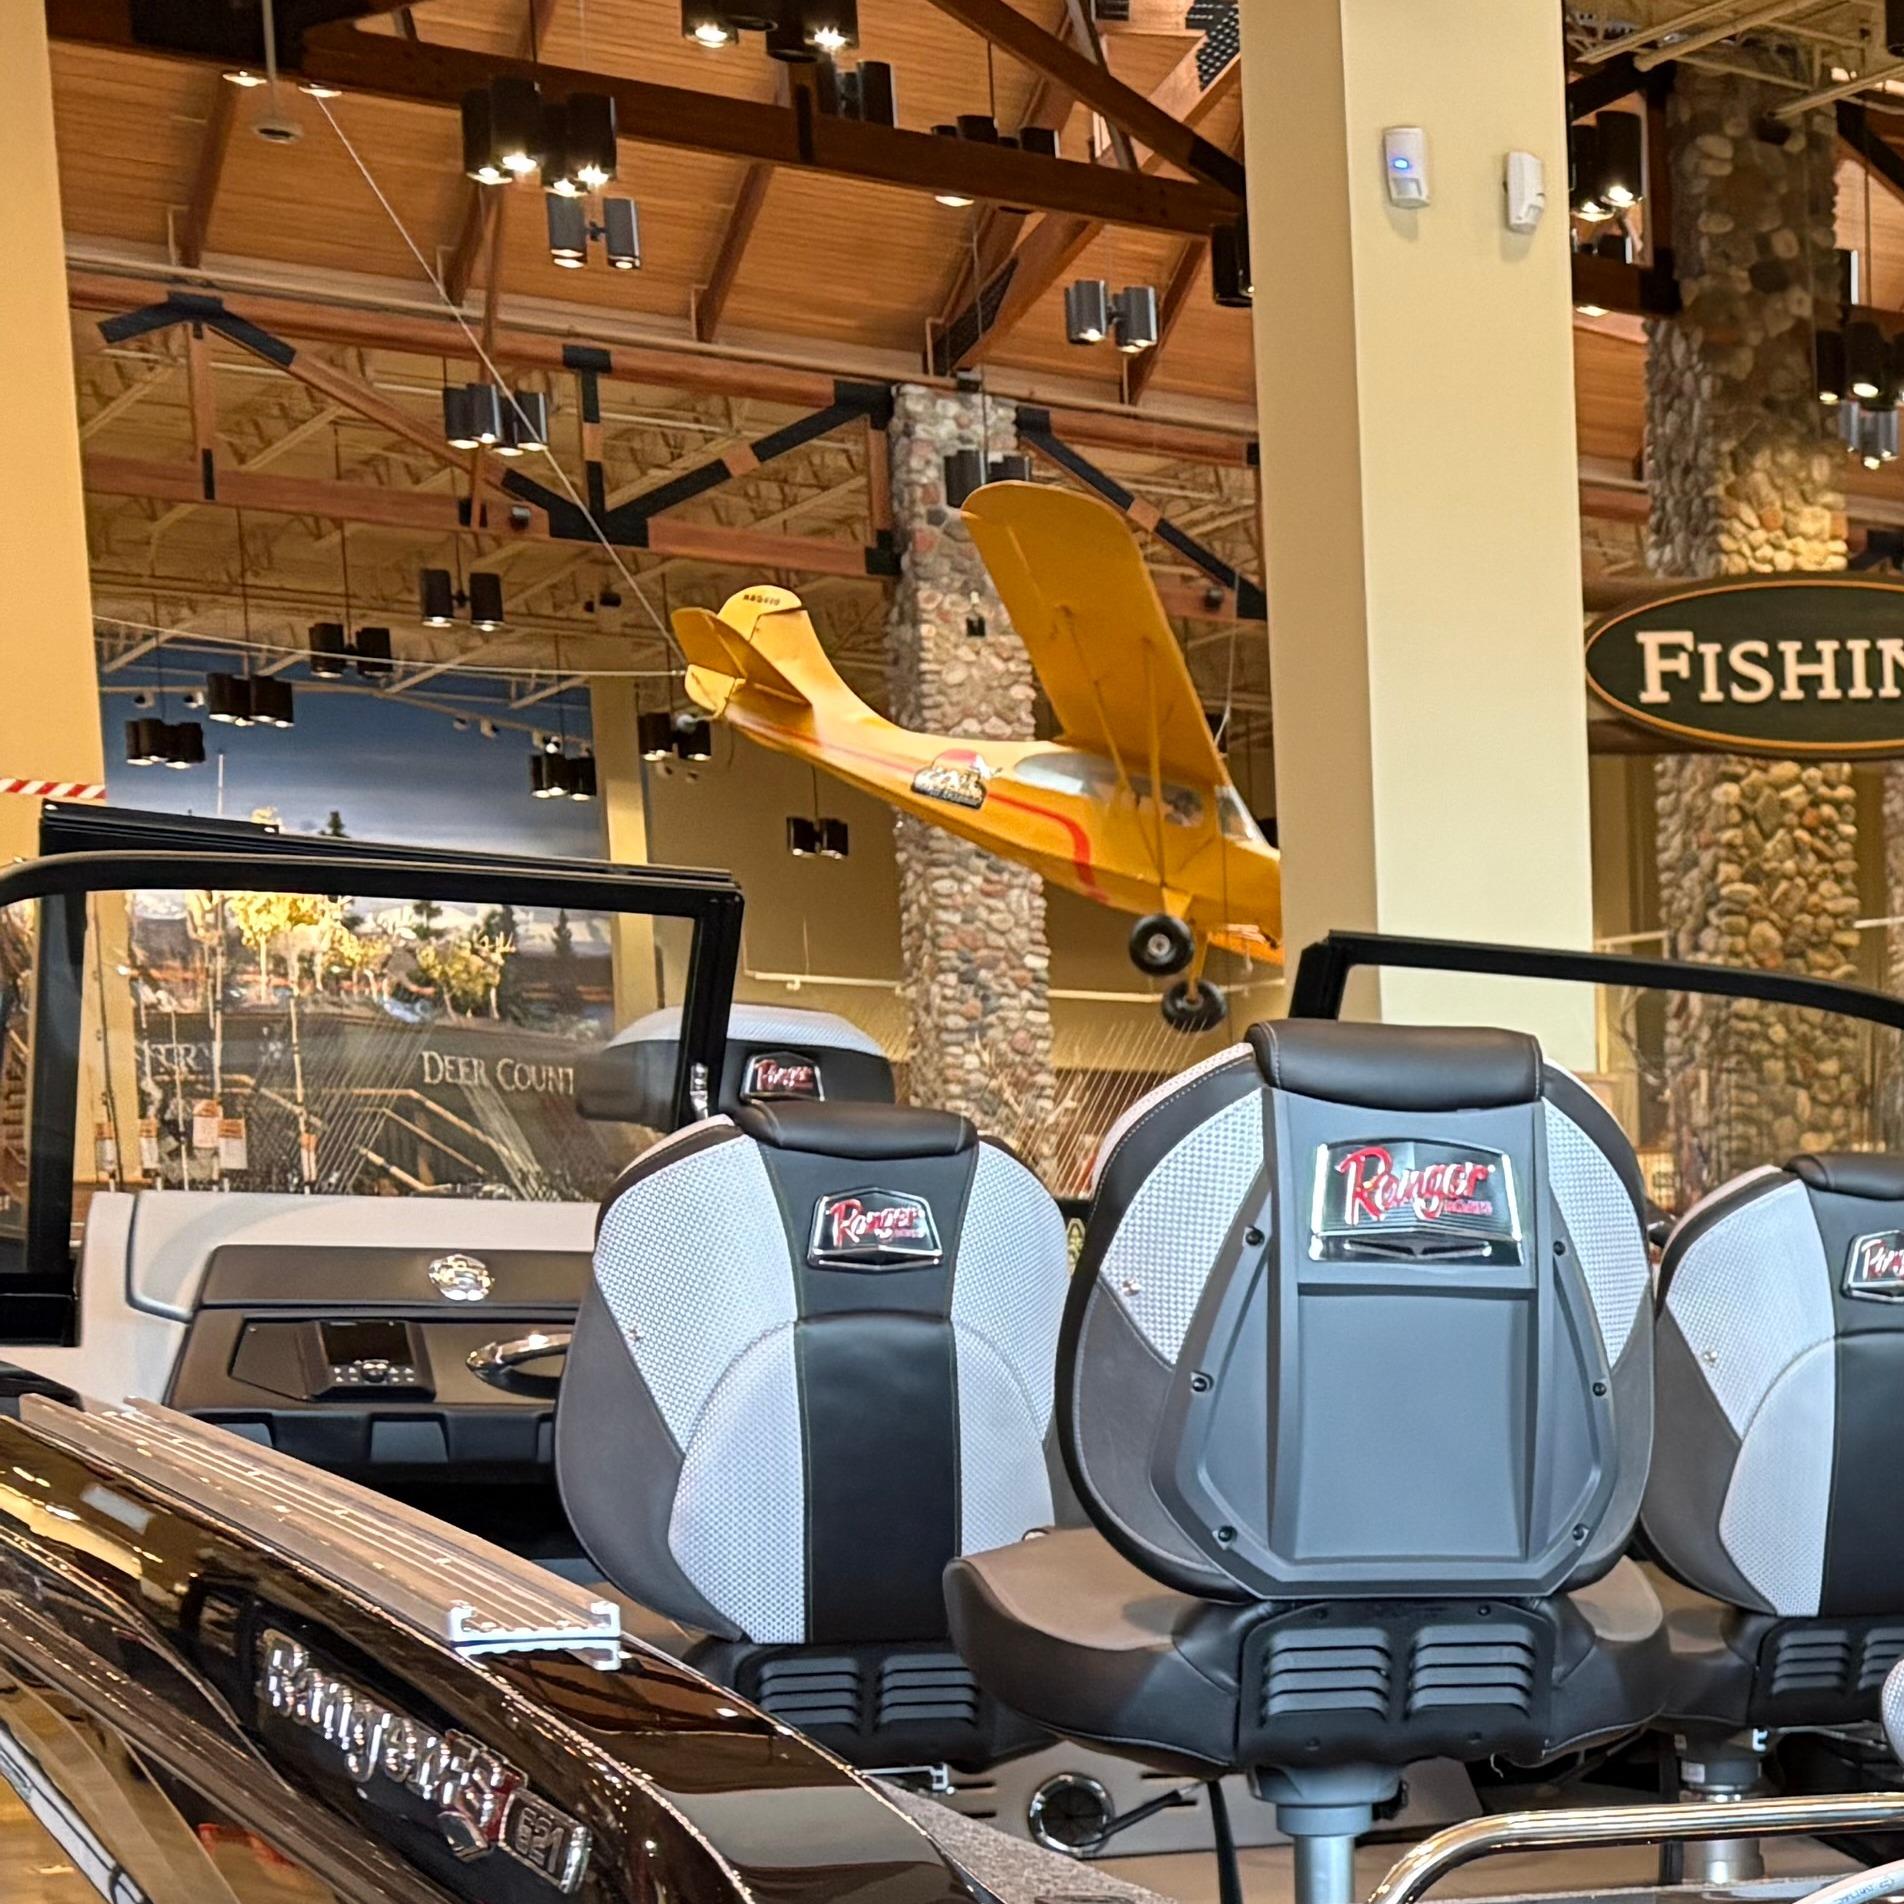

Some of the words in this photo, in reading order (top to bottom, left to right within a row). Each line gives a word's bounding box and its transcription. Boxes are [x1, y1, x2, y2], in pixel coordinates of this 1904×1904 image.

[422, 1051, 488, 1086] DEER
[1335, 1145, 1491, 1225] Ranger
[829, 1198, 921, 1248] Ranger
